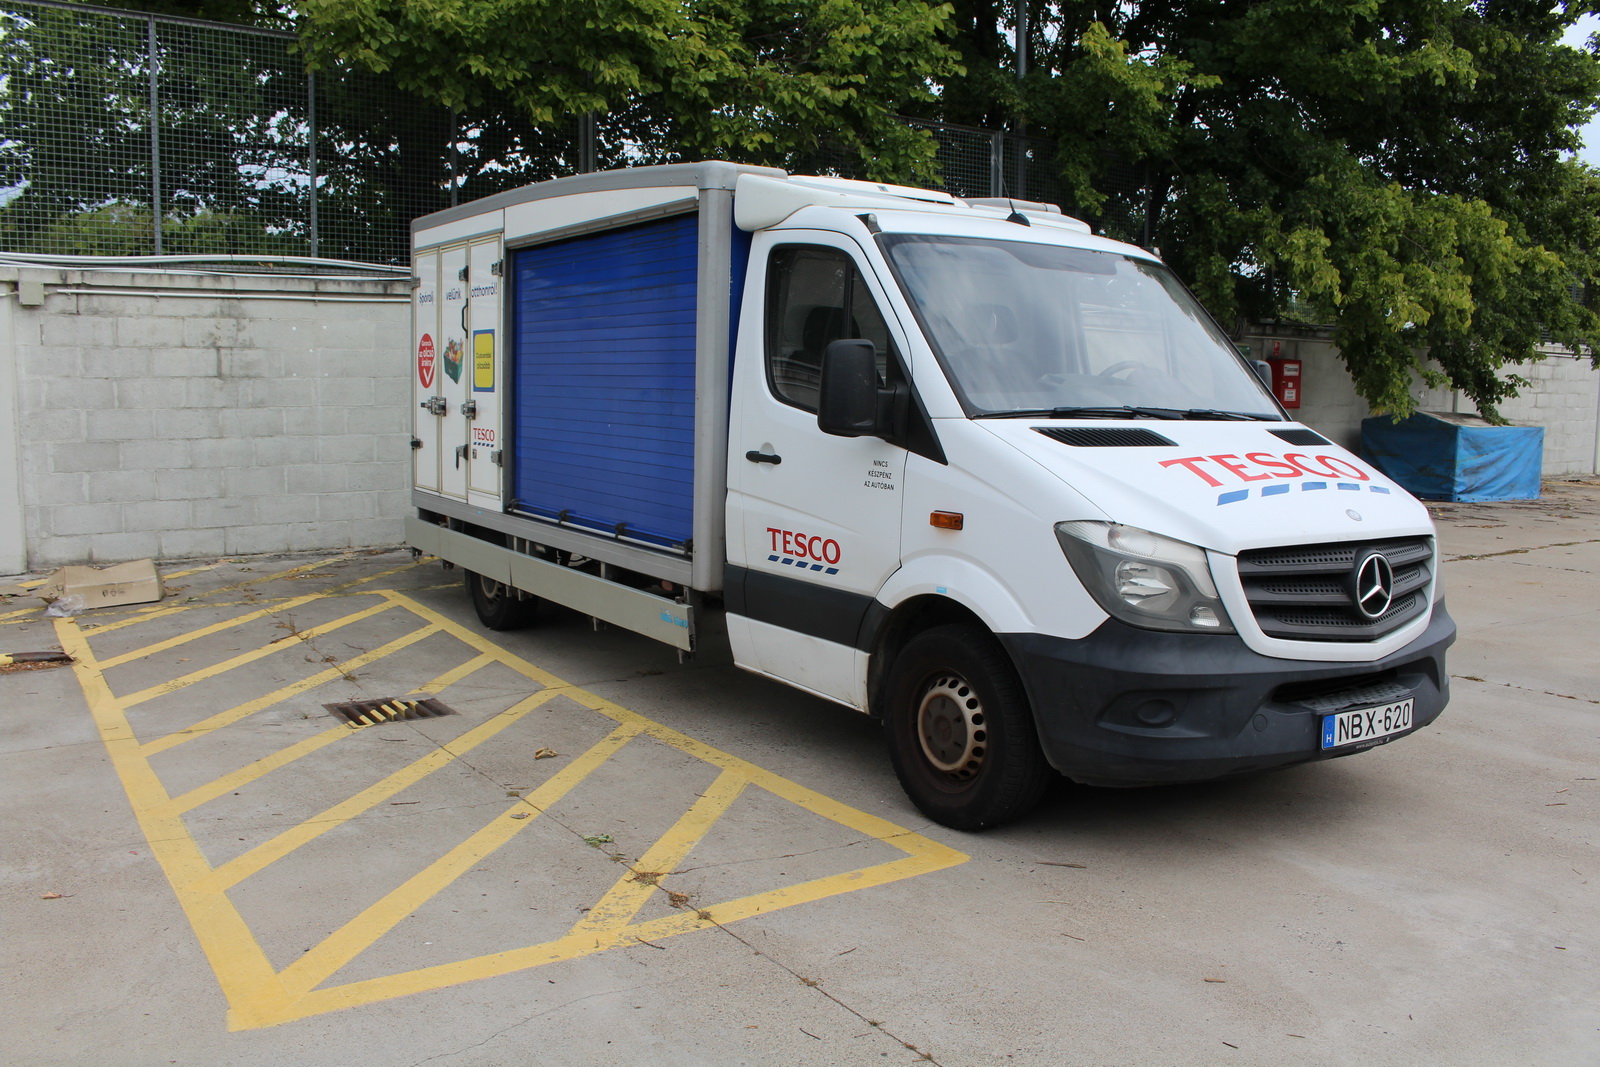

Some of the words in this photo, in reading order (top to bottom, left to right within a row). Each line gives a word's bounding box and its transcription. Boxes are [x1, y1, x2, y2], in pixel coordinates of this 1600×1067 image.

[446, 288, 461, 300] velünk
[471, 282, 497, 298] otthonról!
[473, 428, 495, 441] TESCO
[873, 460, 888, 468] NINCS
[1158, 452, 1370, 487] TESCO
[868, 469, 892, 479] KÉSZPÉNZ
[871, 481, 895, 490] AUTÓBAN
[767, 527, 841, 565] TESCO
[1326, 734, 1332, 743] H
[1339, 703, 1410, 742] NBX-620
